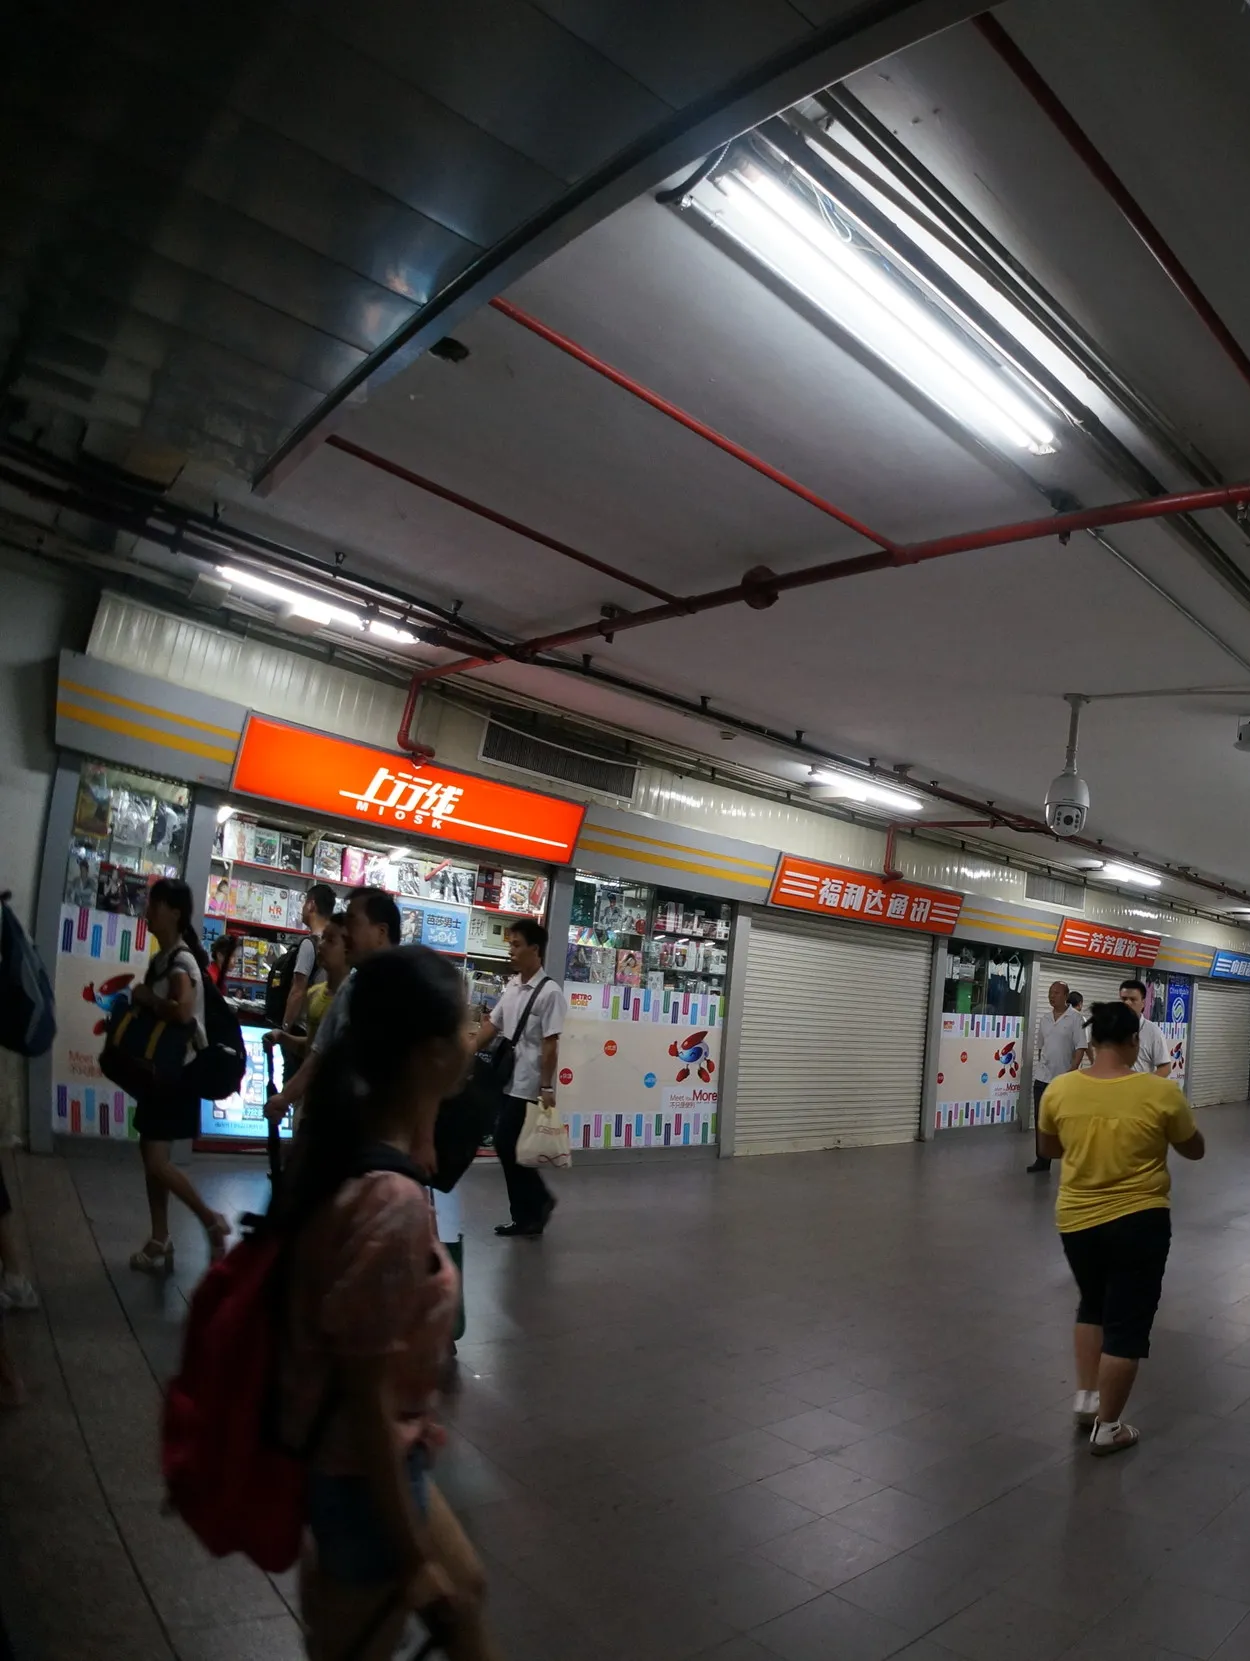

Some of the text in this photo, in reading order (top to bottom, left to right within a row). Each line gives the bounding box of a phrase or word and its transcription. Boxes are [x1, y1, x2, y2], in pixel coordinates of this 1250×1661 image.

[339, 767, 464, 819] 上行线
[355, 800, 443, 829] MIOSK
[818, 878, 932, 924] 福利达通讯
[426, 913, 462, 929] 芭莎男士
[1088, 932, 1139, 958] 芳芳服饰
[692, 1089, 718, 1101] More
